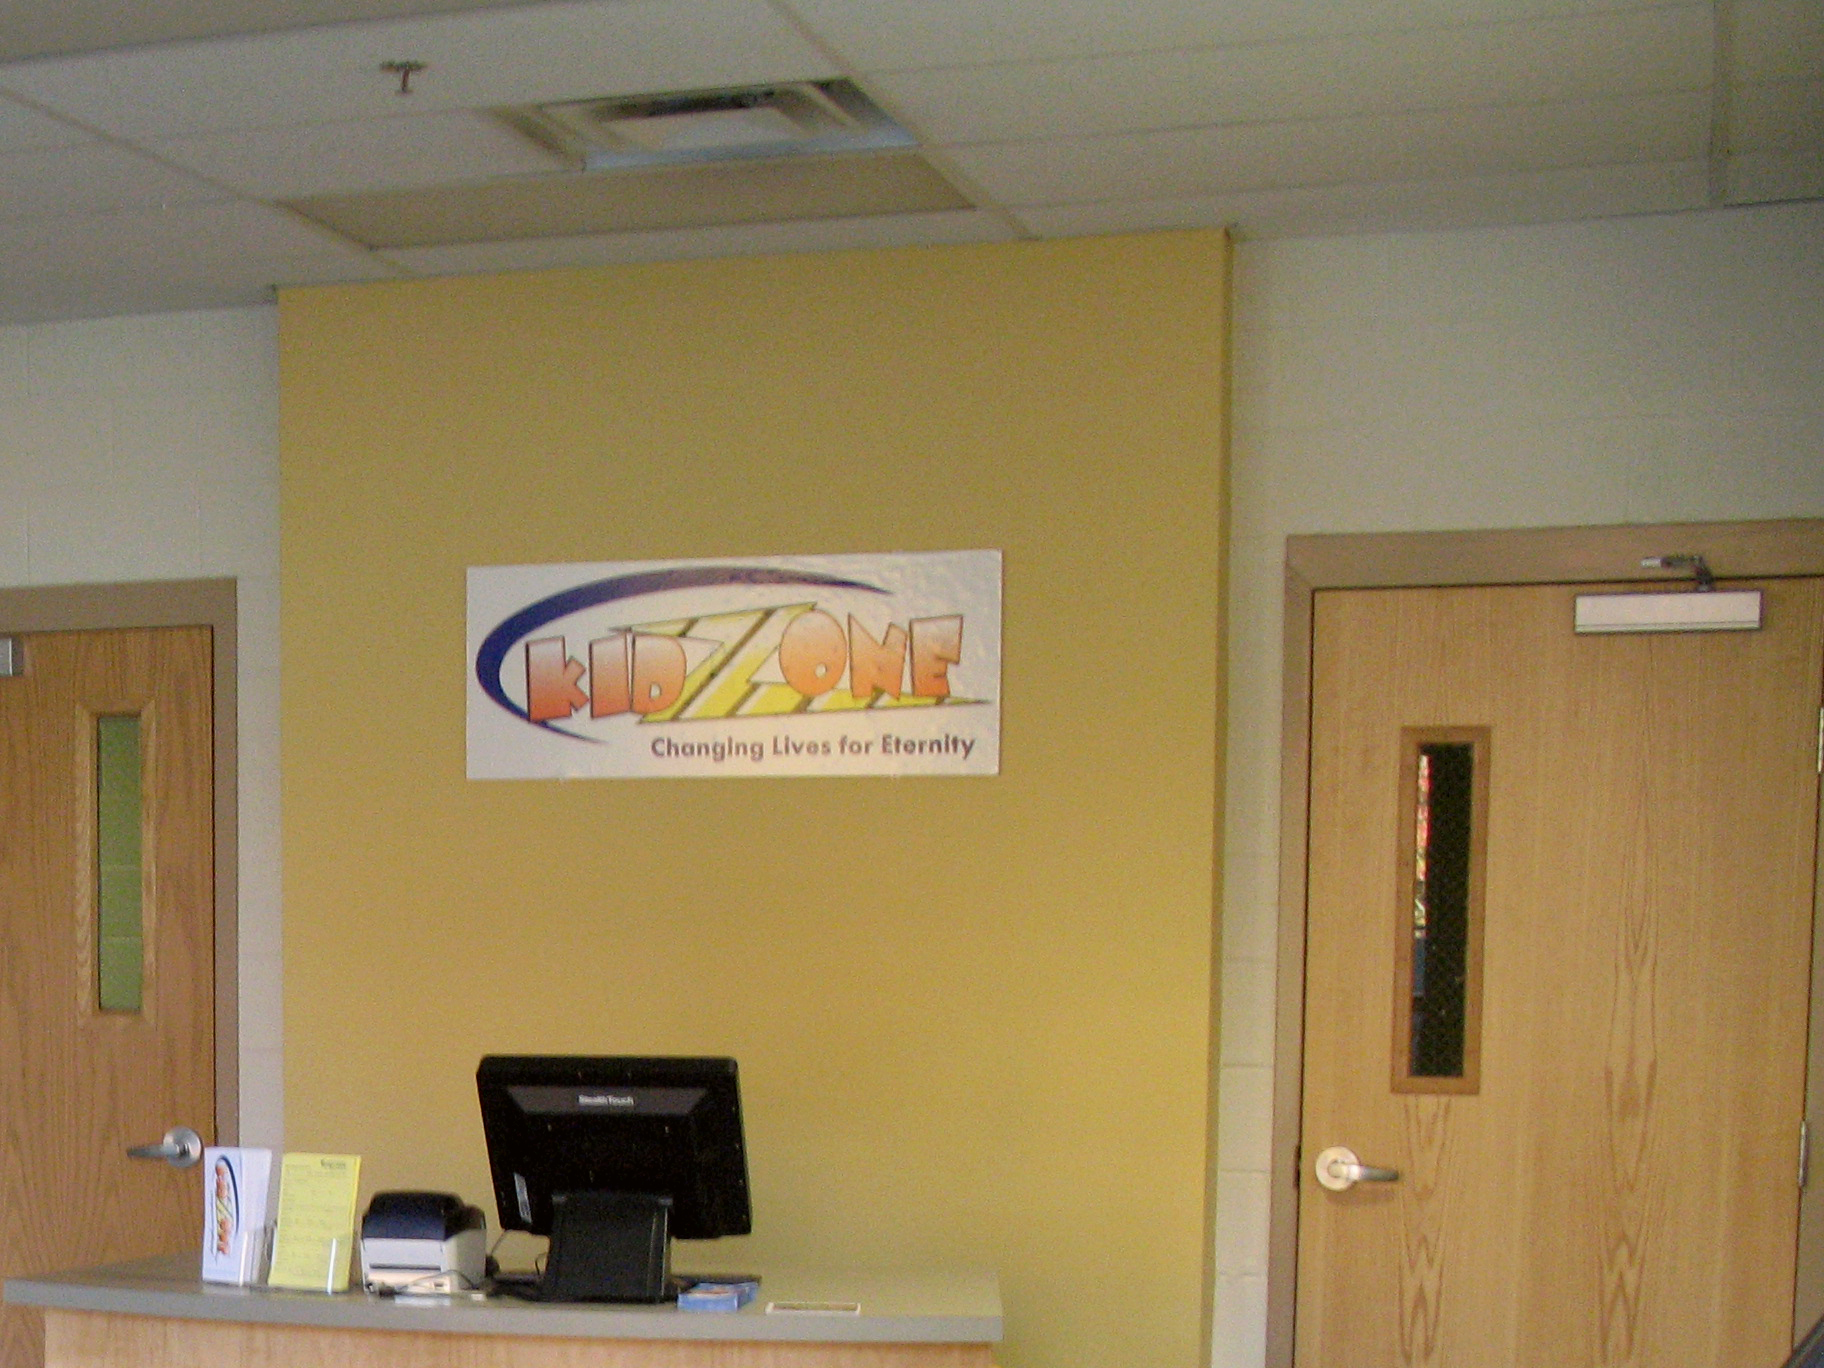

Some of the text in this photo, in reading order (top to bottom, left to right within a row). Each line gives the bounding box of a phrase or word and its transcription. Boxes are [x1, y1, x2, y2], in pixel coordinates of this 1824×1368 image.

[650, 732, 976, 763] Changing Lives for Eternity
